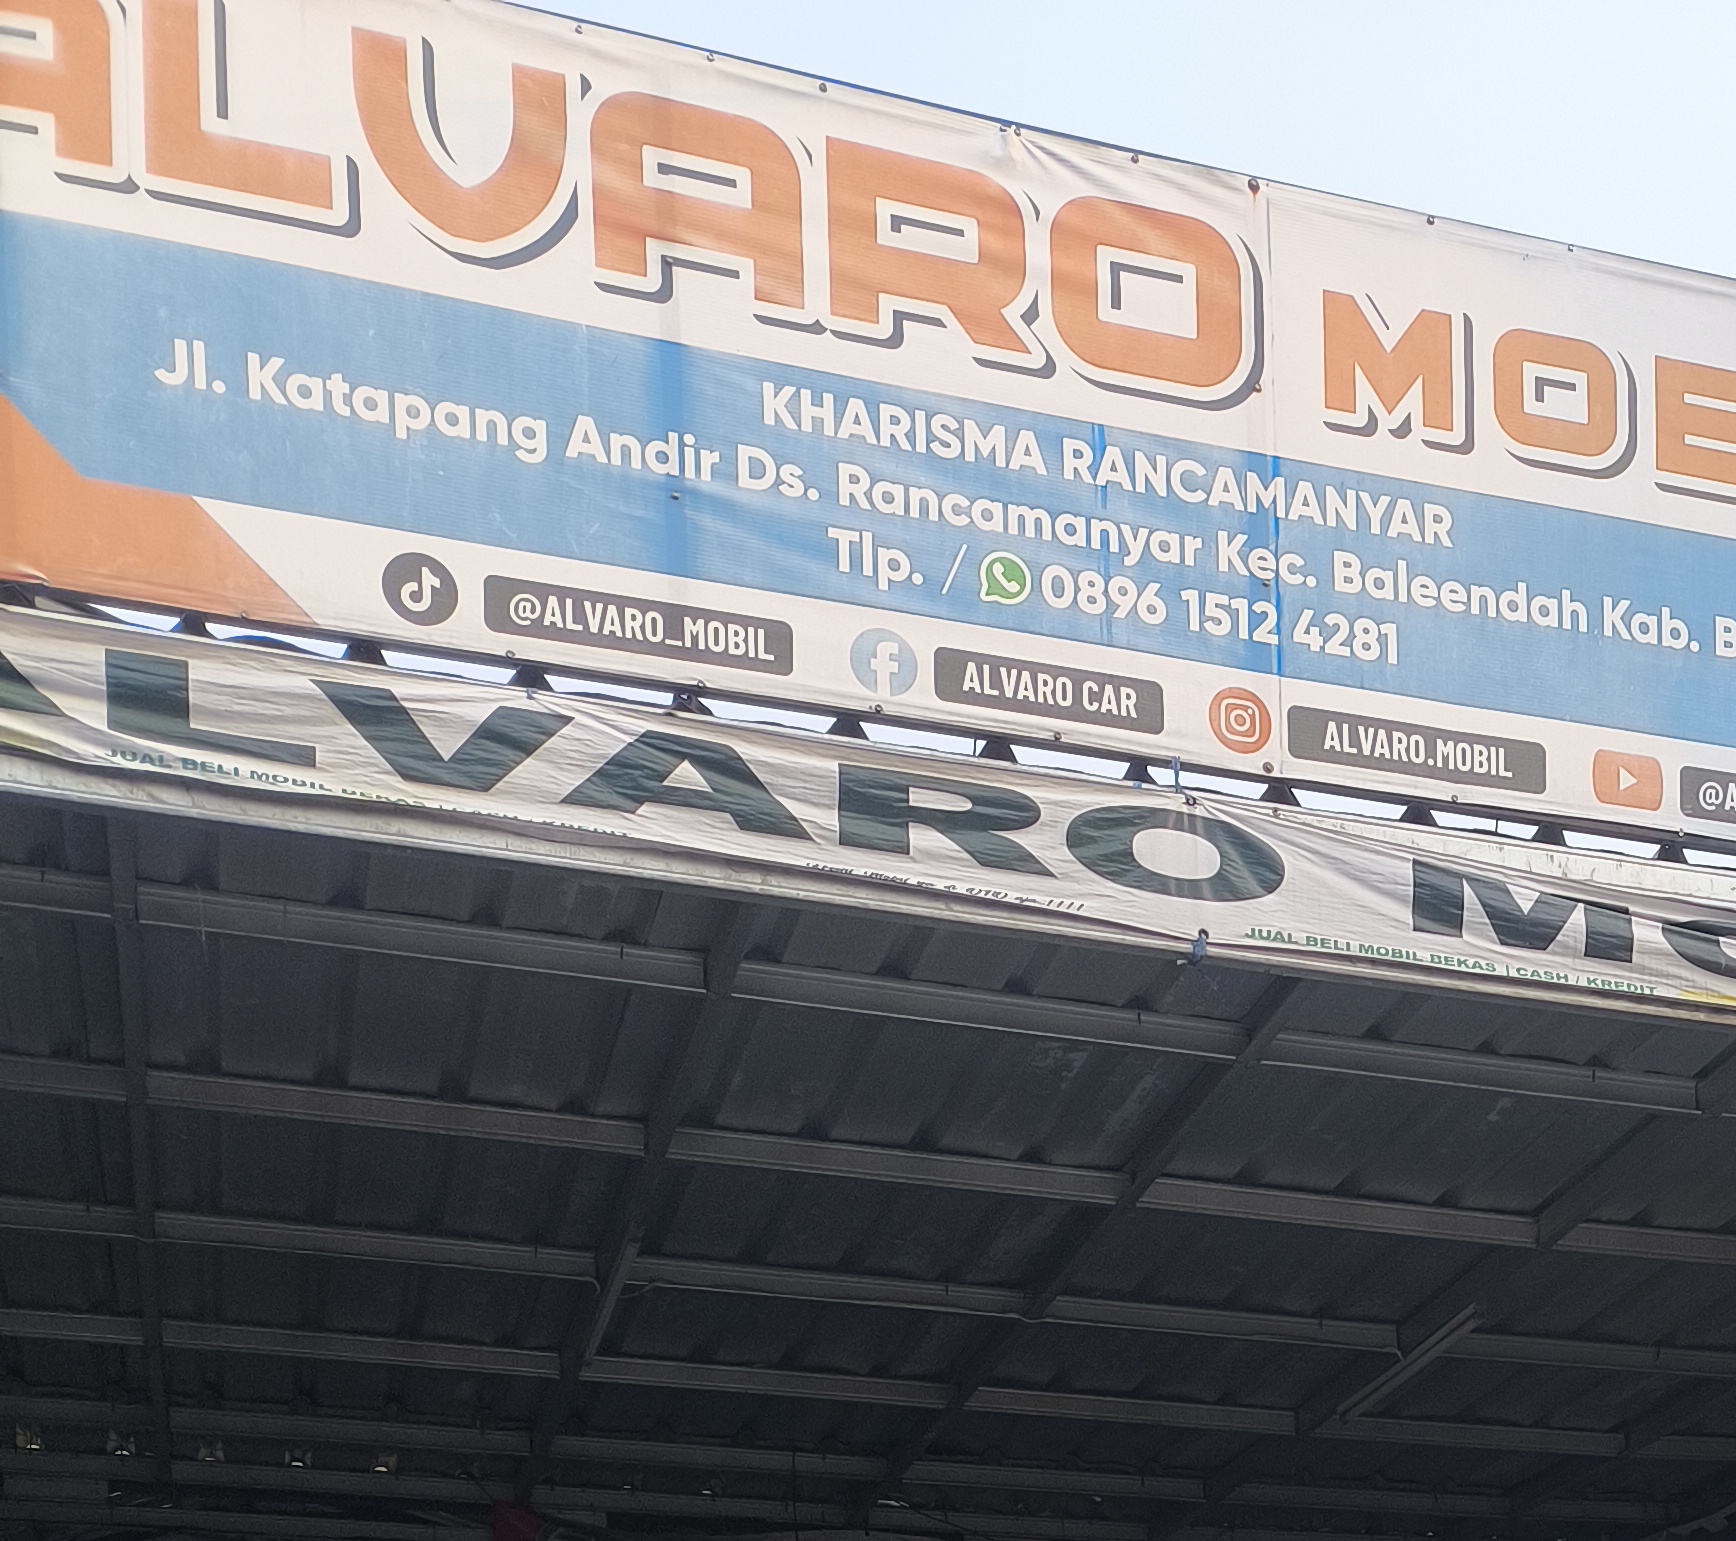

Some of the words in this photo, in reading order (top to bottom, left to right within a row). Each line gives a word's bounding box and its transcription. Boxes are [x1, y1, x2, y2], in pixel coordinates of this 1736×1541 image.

[153, 339, 225, 394] Jl.
[247, 353, 549, 463] Katapang
[566, 415, 719, 482] Andir
[737, 447, 820, 500] Ds.
[838, 464, 1202, 567] Rancamanyar
[1217, 531, 1317, 588] Kec.
[1333, 558, 1588, 633] Baleendah
[1602, 595, 1700, 653] Kab.
[763, 382, 1047, 475] KHARISMA
[1062, 439, 1454, 549] RANCAMANYAR
[508, 592, 775, 663] @ALVARO_MOBIL
[827, 527, 924, 591] Tlp.
[1040, 565, 1168, 625] 0896
[1180, 588, 1279, 646] 1512
[1293, 614, 1399, 665] 4281
[962, 663, 1074, 708] ALVARO
[1081, 678, 1138, 718] CAR
[0, 648, 1286, 902] LVARO
[105, 749, 172, 769] JUAL
[180, 757, 240, 777] BELI
[1323, 722, 1513, 778] ALVARO.MOBIL
[1244, 927, 1298, 944] JUAL
[1305, 935, 1350, 951] BELI
[1359, 943, 1423, 962] MOBIL
[1429, 953, 1496, 972] BEKAS
[1515, 967, 1569, 983] CASH
[1586, 976, 1657, 995] KREDIT
